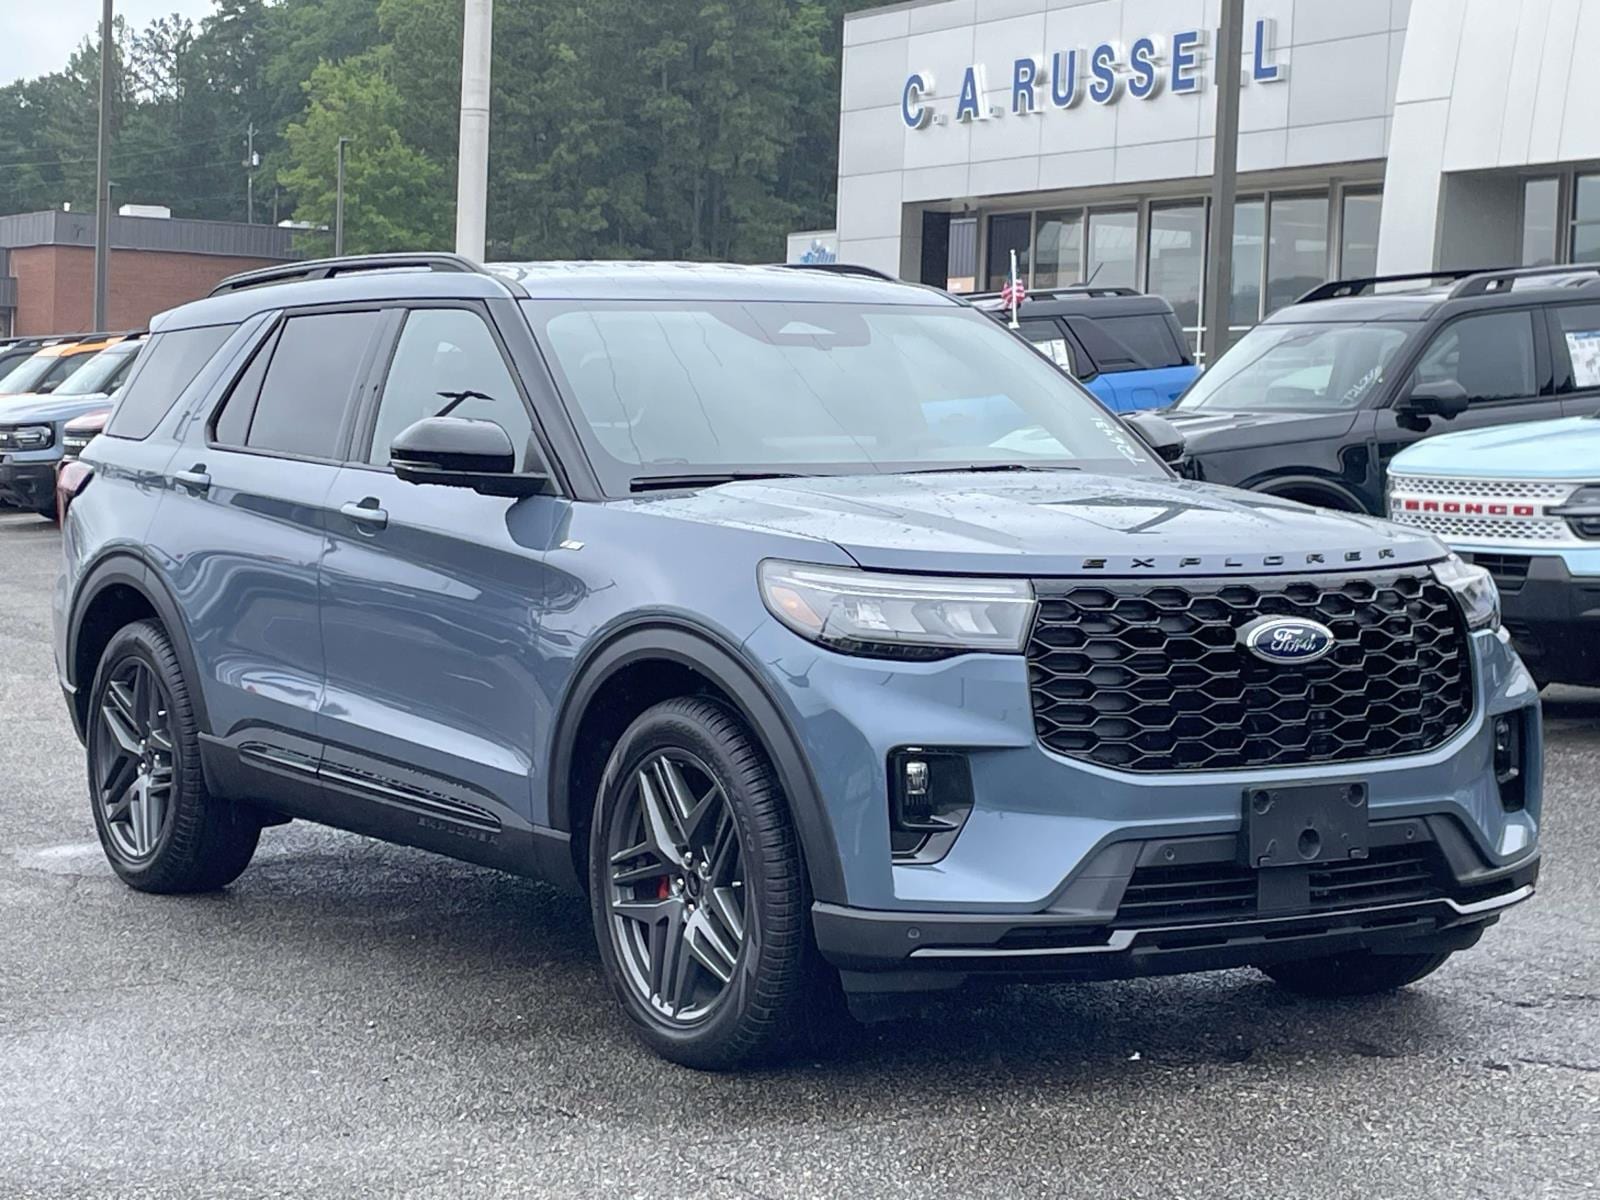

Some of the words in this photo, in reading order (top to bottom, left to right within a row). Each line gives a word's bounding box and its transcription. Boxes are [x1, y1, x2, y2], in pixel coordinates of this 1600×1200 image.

[1012, 18, 1280, 115] RUSSEL
[1405, 499, 1534, 516] BRONCO
[1082, 547, 1395, 570] EXPLORER
[1270, 627, 1317, 653] Ford
